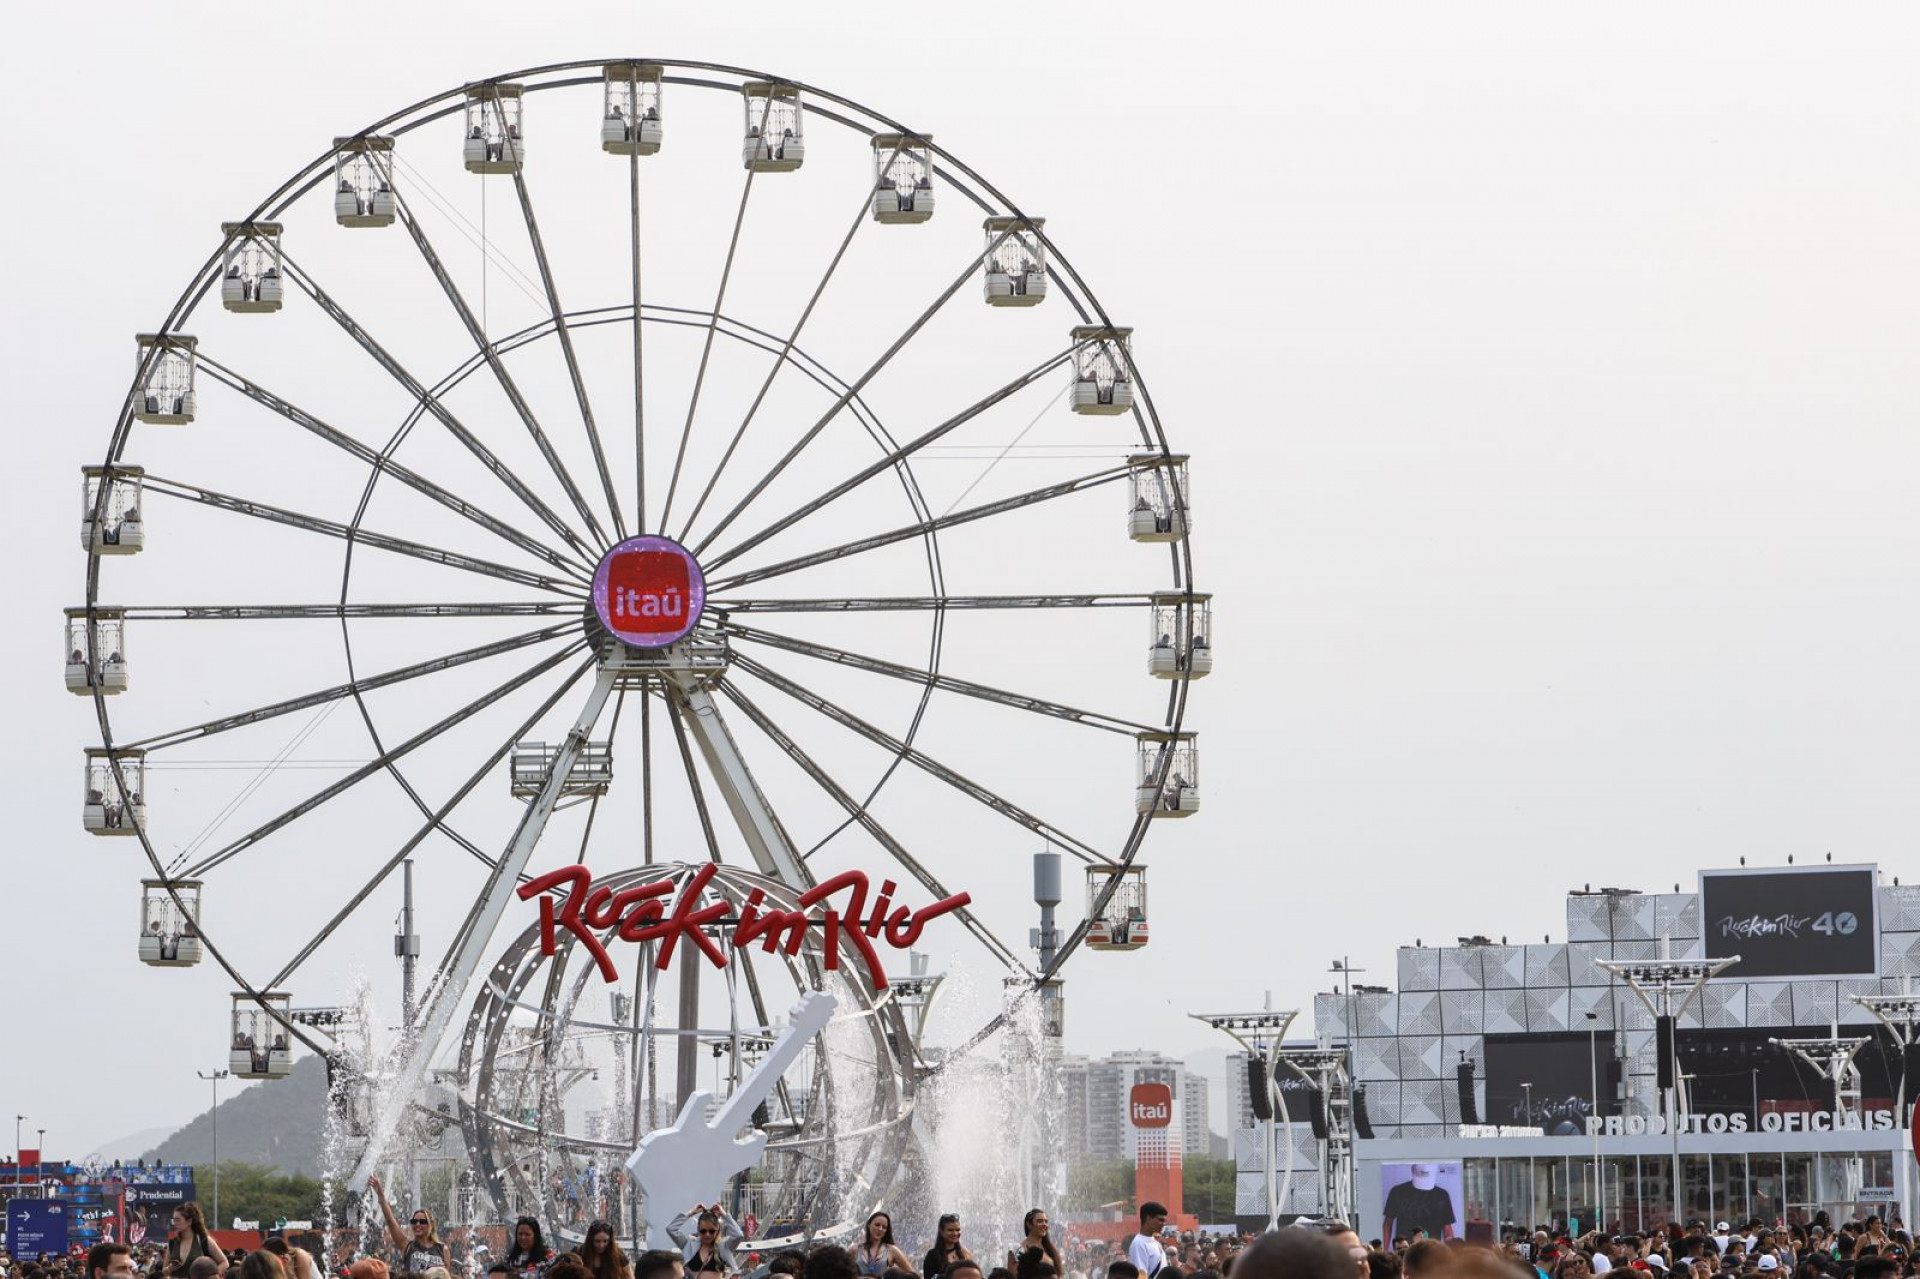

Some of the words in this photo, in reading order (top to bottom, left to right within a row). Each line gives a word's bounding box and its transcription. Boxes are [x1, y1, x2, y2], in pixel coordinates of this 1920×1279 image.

[616, 586, 681, 617] itaú
[516, 862, 732, 984] Rock
[733, 887, 807, 956] in
[798, 869, 972, 991] Rio
[1714, 914, 1763, 940] Rock
[1762, 918, 1777, 934] in
[1774, 913, 1811, 939] Rio
[1133, 1101, 1168, 1119] itaú
[1585, 1112, 1748, 1136] PRODUTOS
[1761, 1109, 1893, 1133] OFICIAIS
[140, 1190, 183, 1199] Prudential
[1859, 1190, 1894, 1198] ENTRADA
